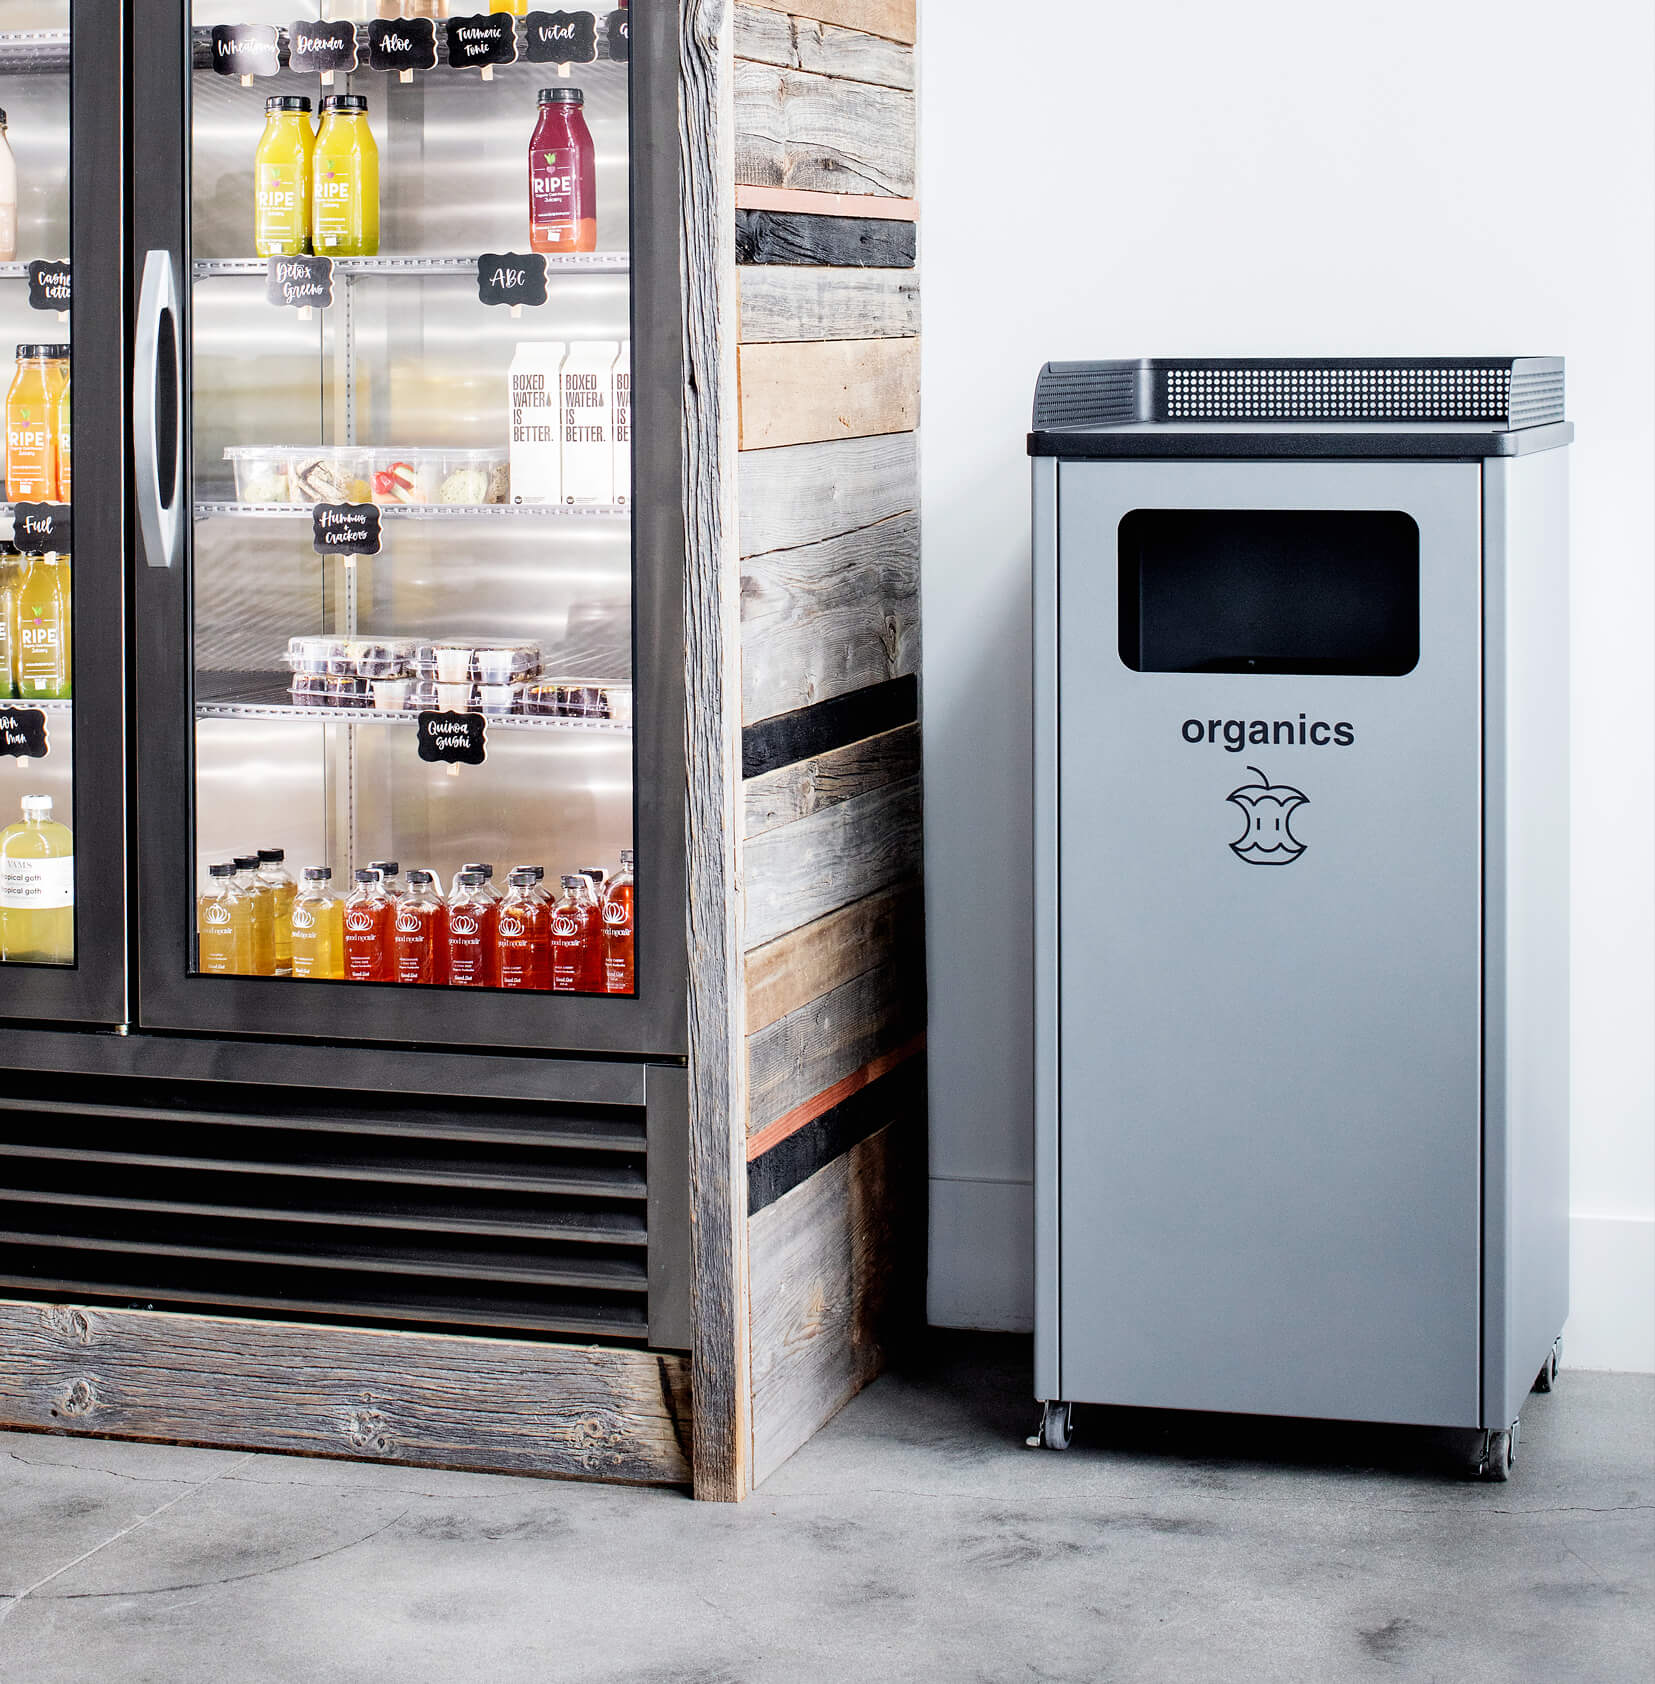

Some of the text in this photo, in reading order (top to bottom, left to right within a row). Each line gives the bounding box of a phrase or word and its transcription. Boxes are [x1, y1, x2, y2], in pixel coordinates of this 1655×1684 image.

[456, 25, 502, 42] Turmeric
[538, 24, 575, 41] Vital
[379, 35, 412, 53] Aloe
[464, 41, 490, 57] Tonic
[315, 182, 349, 197] RIPE
[534, 176, 572, 193] RIPE
[259, 191, 295, 206] RIPE
[38, 271, 71, 286] Cashe
[276, 262, 312, 283] Detox
[490, 268, 526, 289] ABC
[283, 282, 324, 304] Greens
[512, 374, 544, 391] BOXED
[566, 374, 597, 391] BOXED
[512, 392, 545, 407] WATER
[566, 392, 598, 407] WATER
[513, 409, 522, 425] IS
[566, 409, 575, 424] IS
[617, 408, 626, 424] IS
[9, 431, 44, 446] RIPE
[513, 426, 554, 442] BETTER.
[566, 426, 606, 442] BETTER.
[23, 516, 54, 535] Fuel
[319, 510, 367, 528] Hummus
[325, 529, 368, 545] Crackers
[22, 628, 57, 644] RIPE
[428, 720, 469, 736] Quinoa
[1181, 713, 1355, 753] organics
